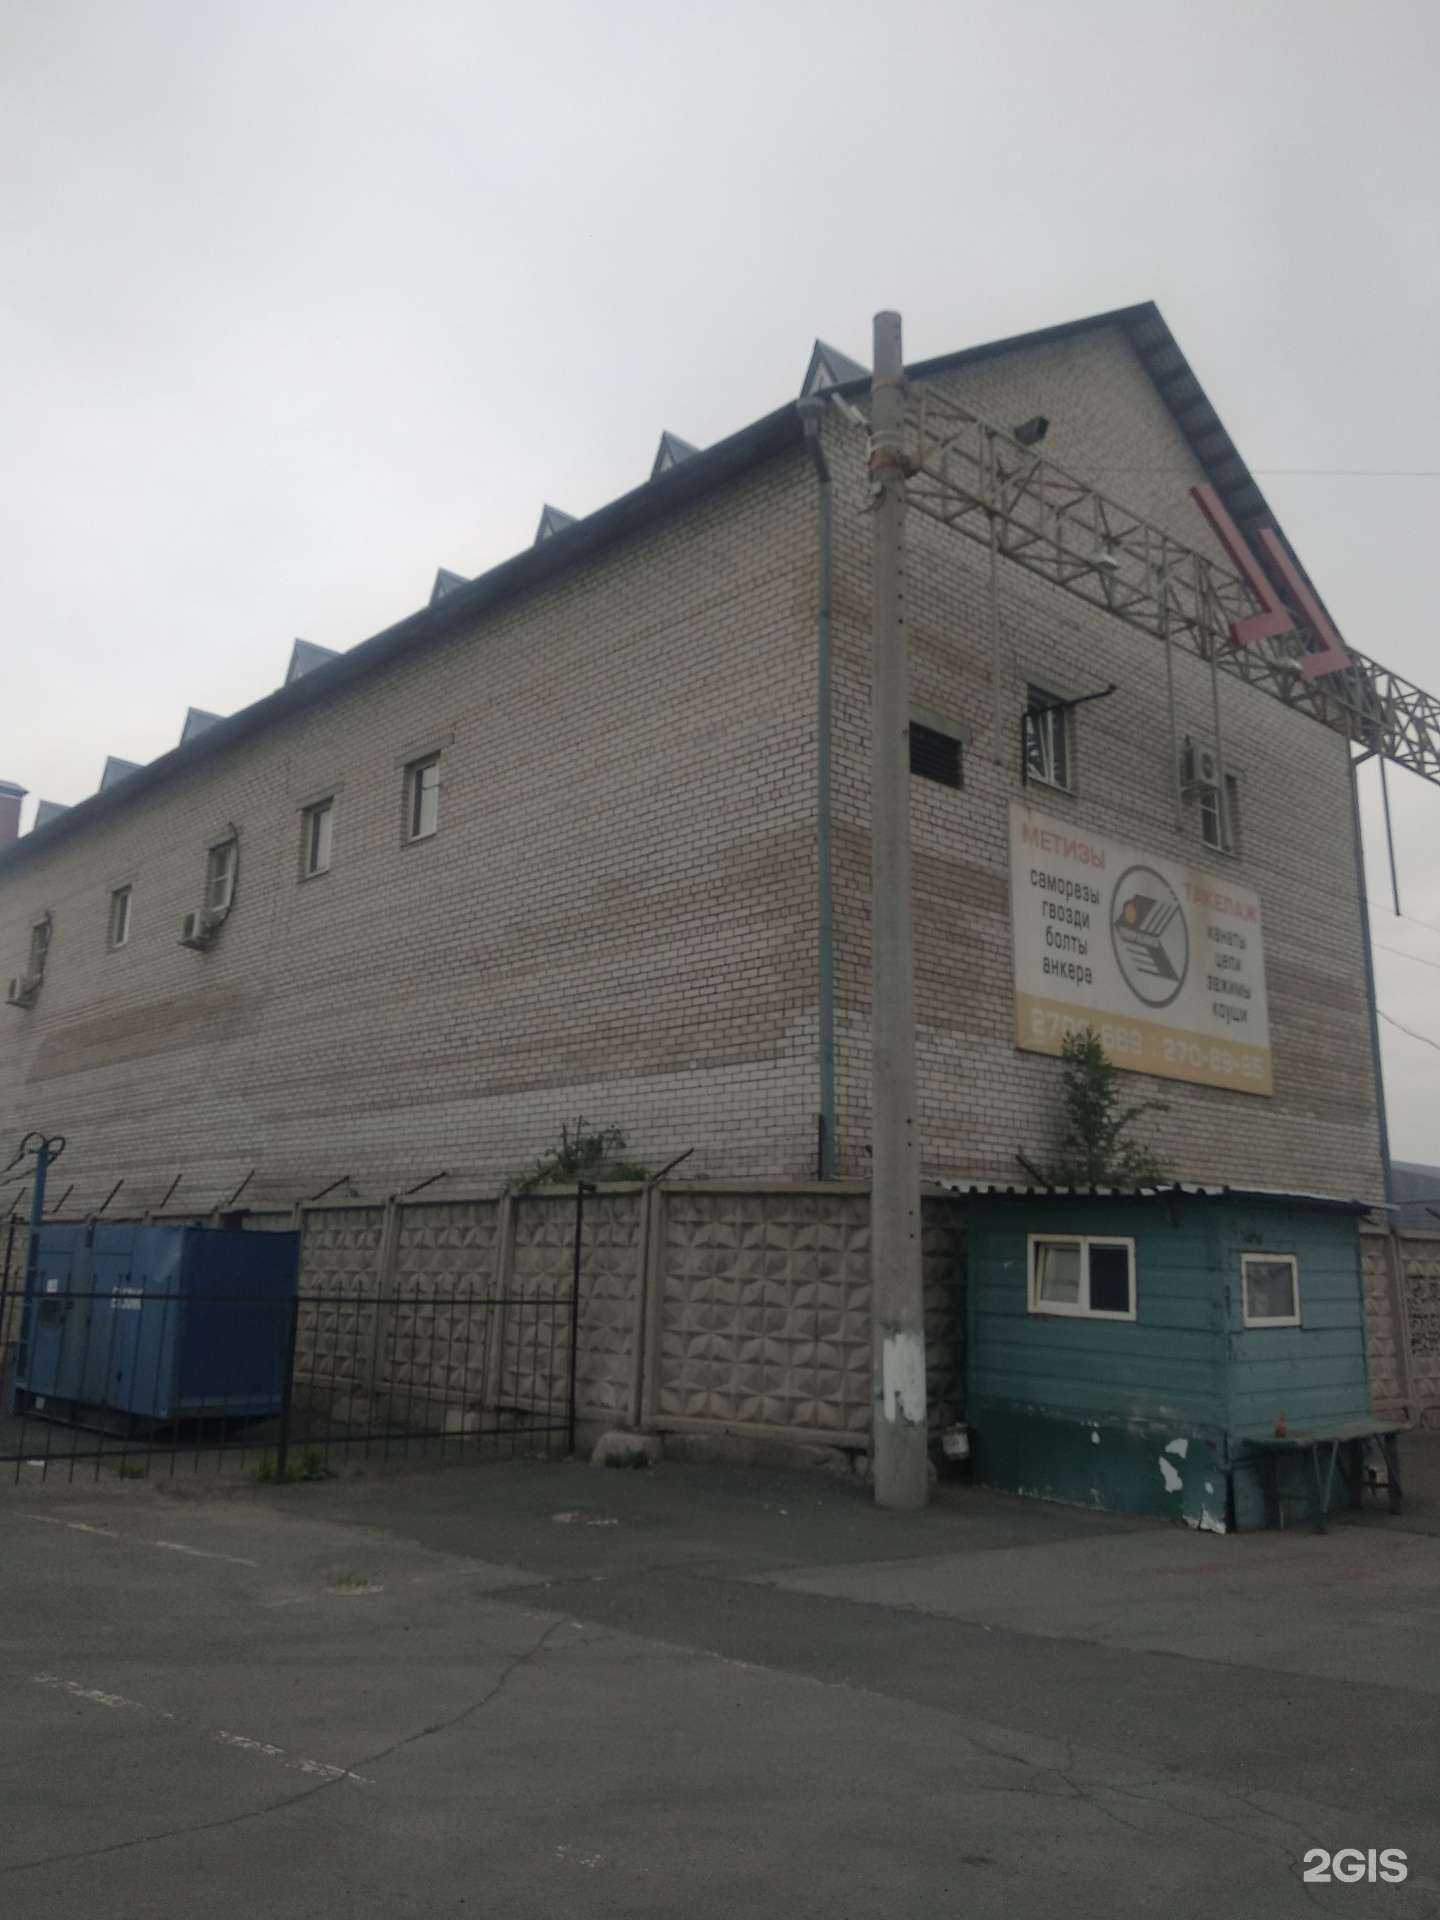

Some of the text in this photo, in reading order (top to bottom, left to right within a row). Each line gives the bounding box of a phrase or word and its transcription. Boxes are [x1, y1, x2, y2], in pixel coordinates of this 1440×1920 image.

[1022, 822, 1105, 869] МЕТИЗЫ
[1030, 867, 1100, 905] саморезы
[1041, 900, 1090, 929] гвозди
[1045, 926, 1088, 955] болты
[1042, 956, 1092, 986] анкера
